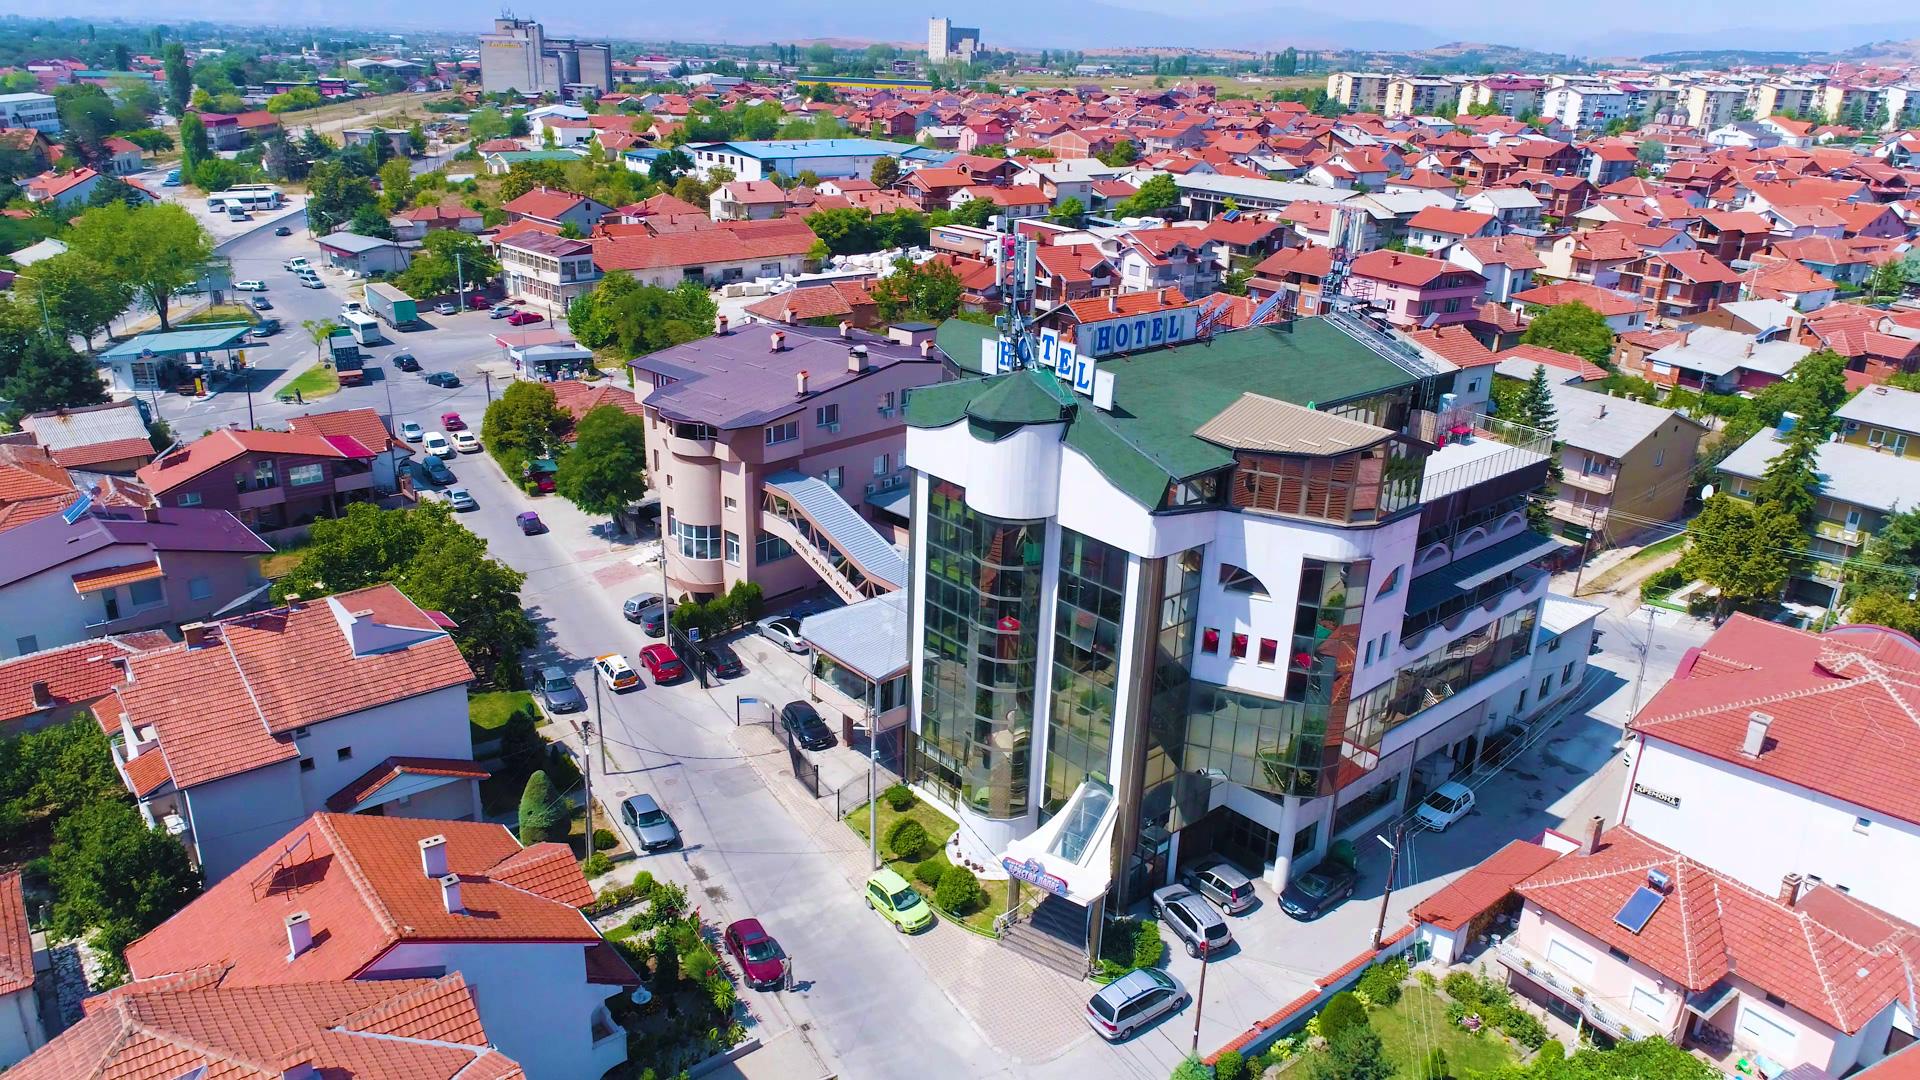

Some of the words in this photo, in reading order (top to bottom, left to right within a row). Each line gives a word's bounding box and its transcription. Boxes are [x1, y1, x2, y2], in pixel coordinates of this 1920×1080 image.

[1097, 315, 1179, 351] HOTEL
[1000, 334, 1090, 390] HOTEL
[795, 539, 809, 557] HOTEL
[812, 556, 833, 581] KRISTAL
[835, 580, 852, 600] PALAS
